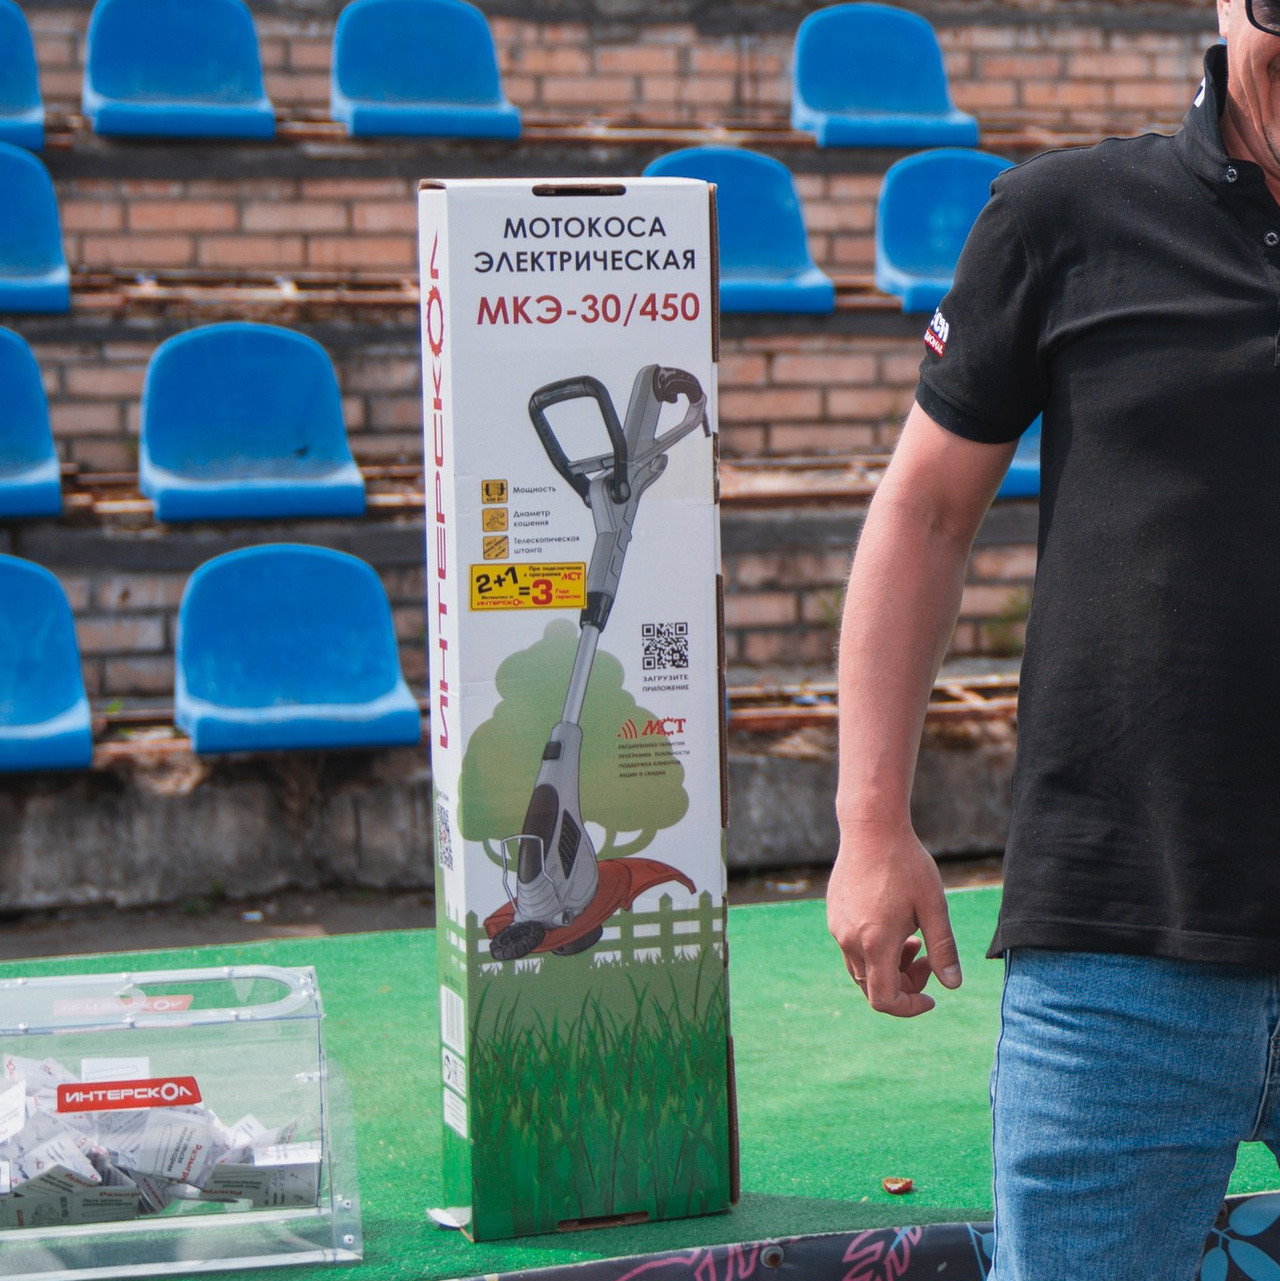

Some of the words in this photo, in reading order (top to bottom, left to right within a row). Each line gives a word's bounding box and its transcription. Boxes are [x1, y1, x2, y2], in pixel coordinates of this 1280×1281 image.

[503, 216, 667, 239] МОТОКОСА
[474, 249, 696, 273] ЭЛЕКТРИЧЕСКАЯ
[477, 292, 700, 327] МКЭ-30/450
[426, 228, 449, 750] ИНТЕРСКОЛ
[513, 486, 557, 494] Мощность
[513, 510, 551, 519] Диаметр
[513, 535, 580, 545] Телескопическая
[514, 546, 543, 554] штанга
[643, 674, 689, 682] ЗАГРУЗИТЕ
[642, 684, 690, 692] ПРИЛОЖЕНИЕ
[641, 717, 686, 737] МСТ
[65, 1082, 193, 1103] ИНТЕРСКОЛ
